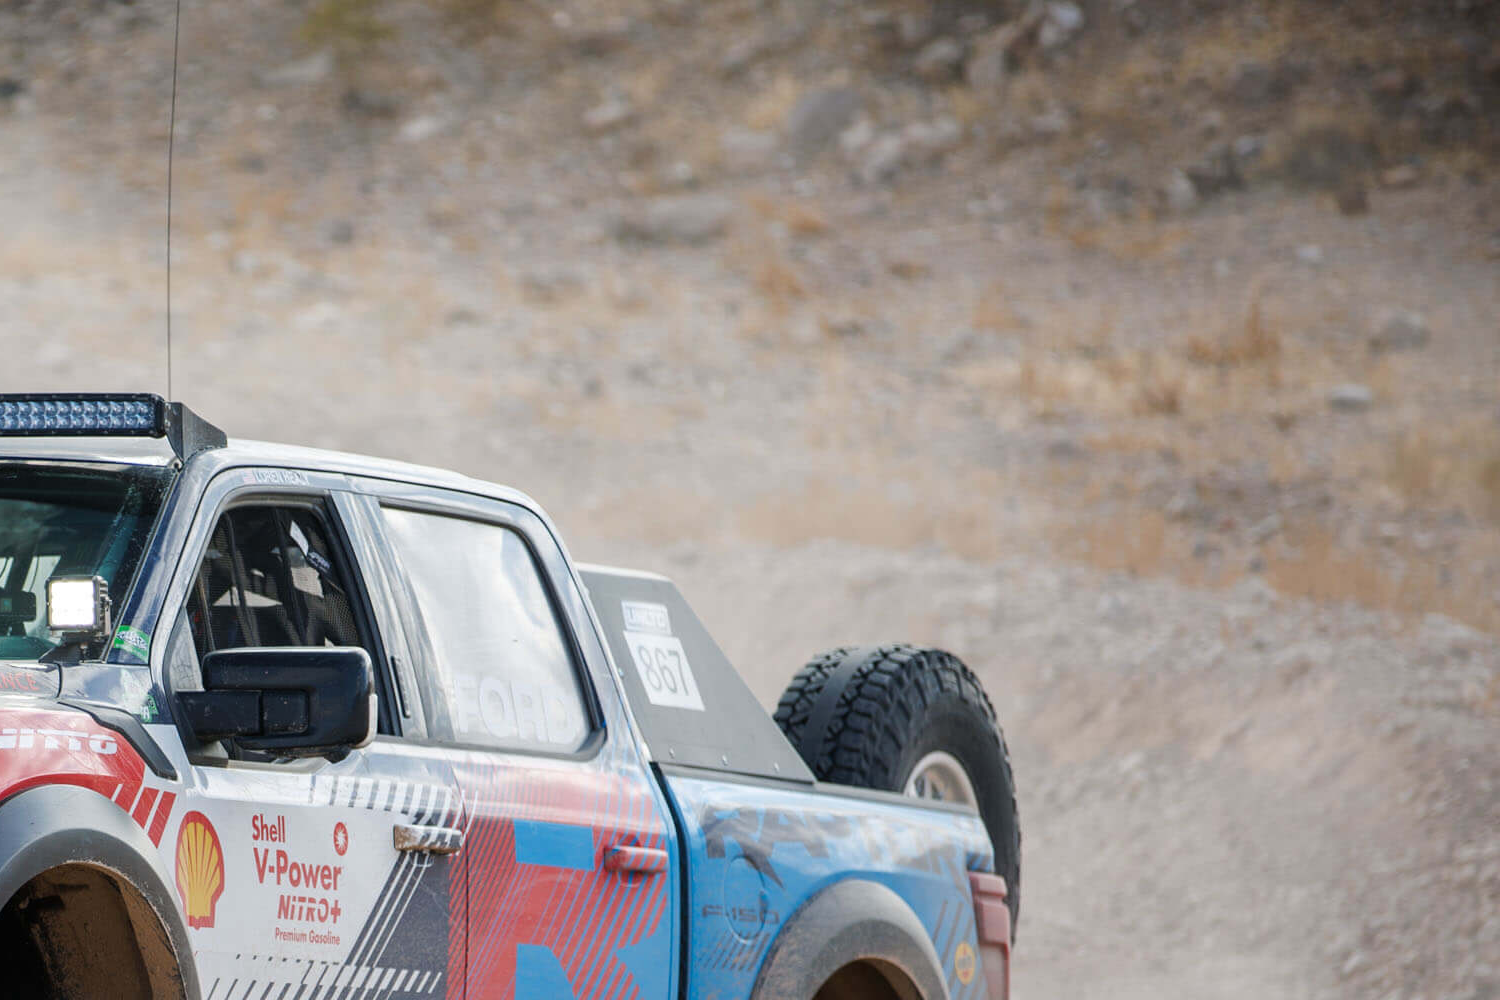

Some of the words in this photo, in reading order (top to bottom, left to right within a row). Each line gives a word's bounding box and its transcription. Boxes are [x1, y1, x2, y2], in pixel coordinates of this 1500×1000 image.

[637, 645, 689, 697] 867
[454, 673, 579, 745] FORD
[251, 813, 286, 843] Shell
[252, 846, 342, 891] V-Power
[275, 926, 307, 943] Premium
[308, 929, 341, 946] Gasoline
